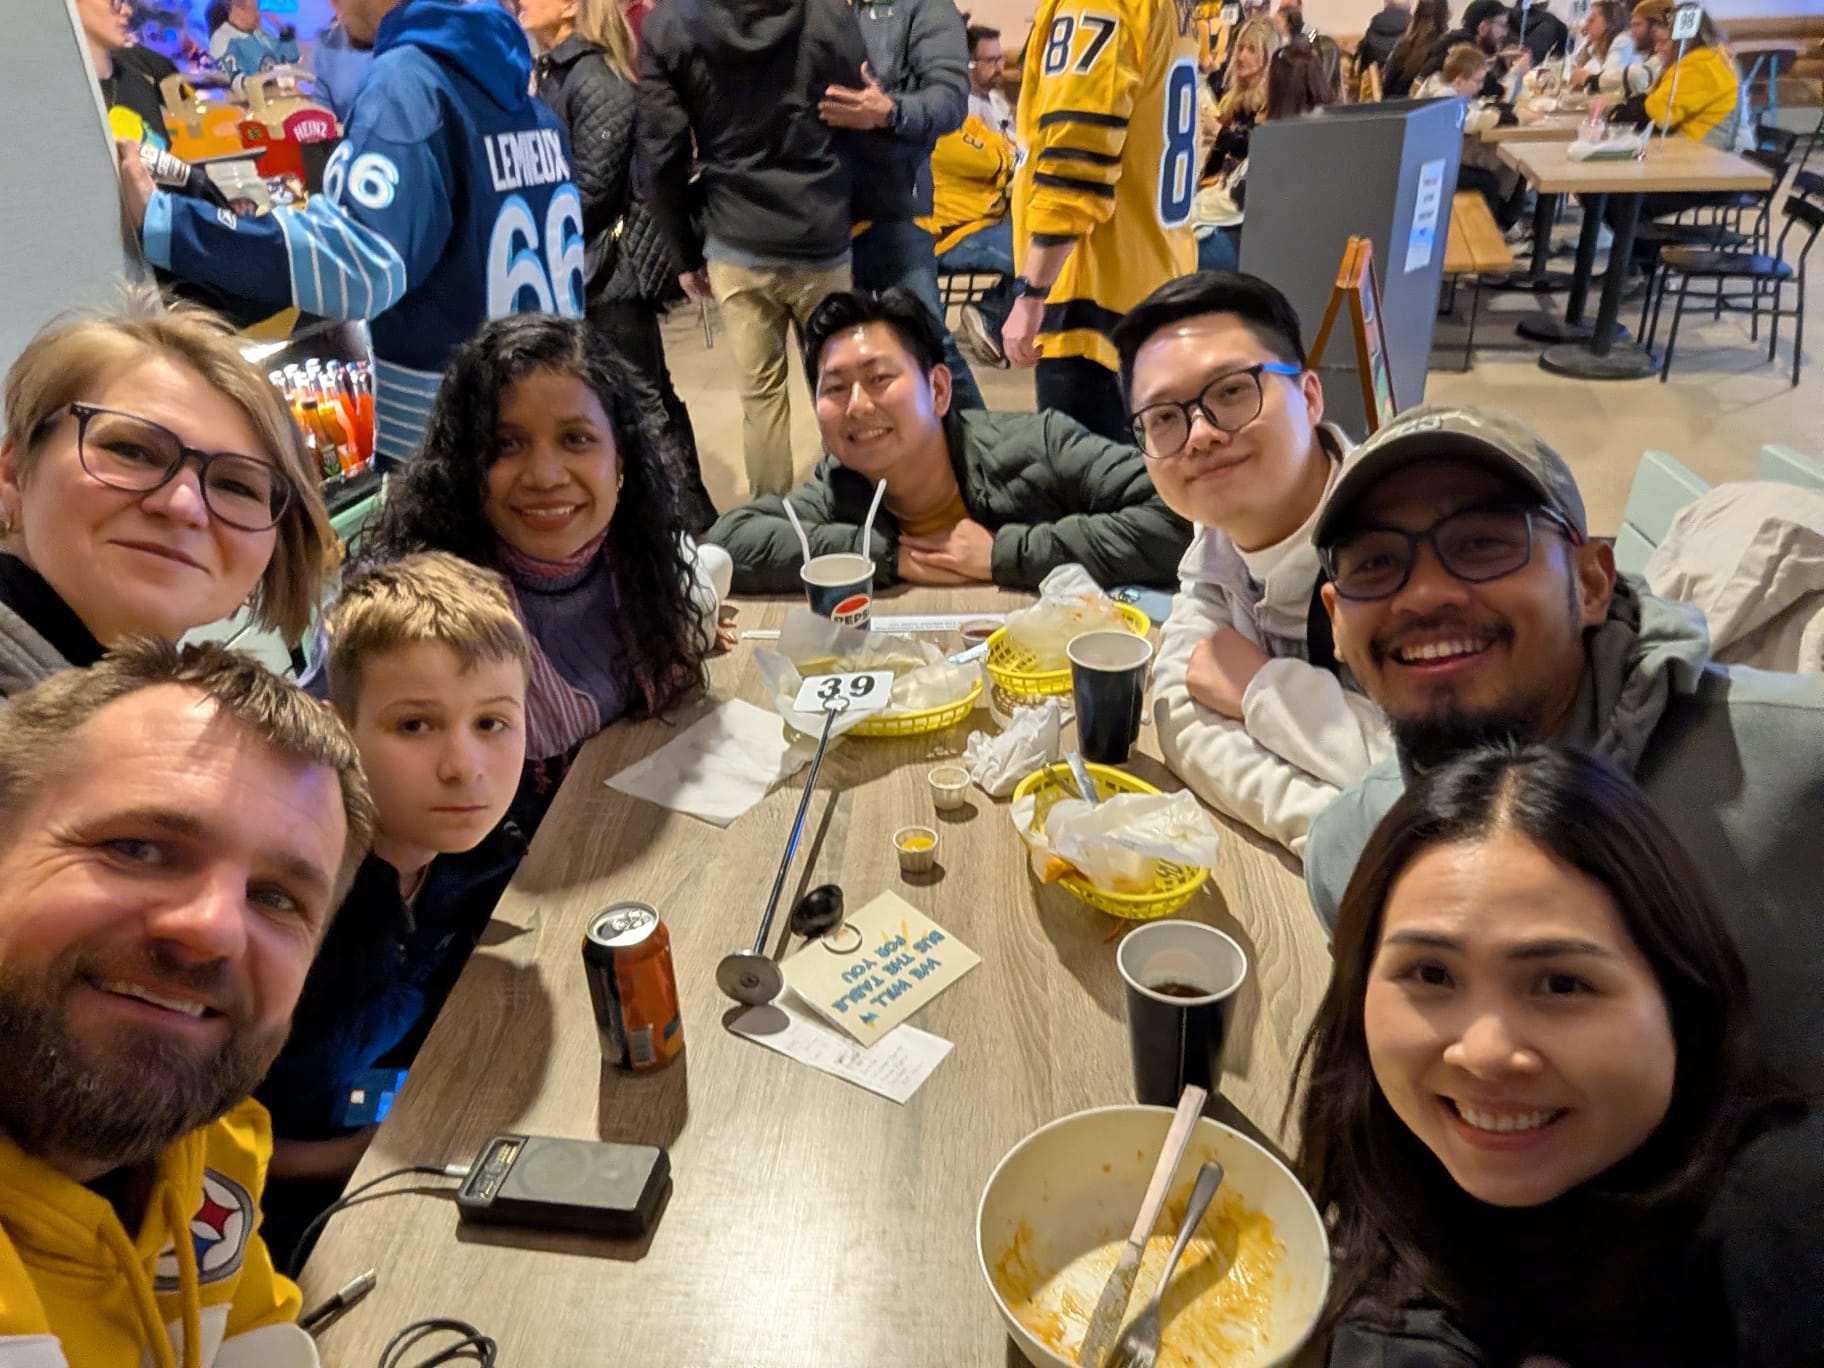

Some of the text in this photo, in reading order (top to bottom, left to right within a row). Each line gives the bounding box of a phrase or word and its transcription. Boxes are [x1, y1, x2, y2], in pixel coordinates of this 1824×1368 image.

[1045, 10, 1119, 75] 87
[293, 120, 328, 143] HEINZ
[484, 128, 571, 192] LEMIEUX
[323, 140, 400, 210] 66
[486, 183, 586, 322] 66
[817, 675, 875, 699] 39
[832, 931, 945, 1012] BUS THE TABLE
[842, 935, 905, 983] FOR YOU
[909, 958, 941, 979] WE
